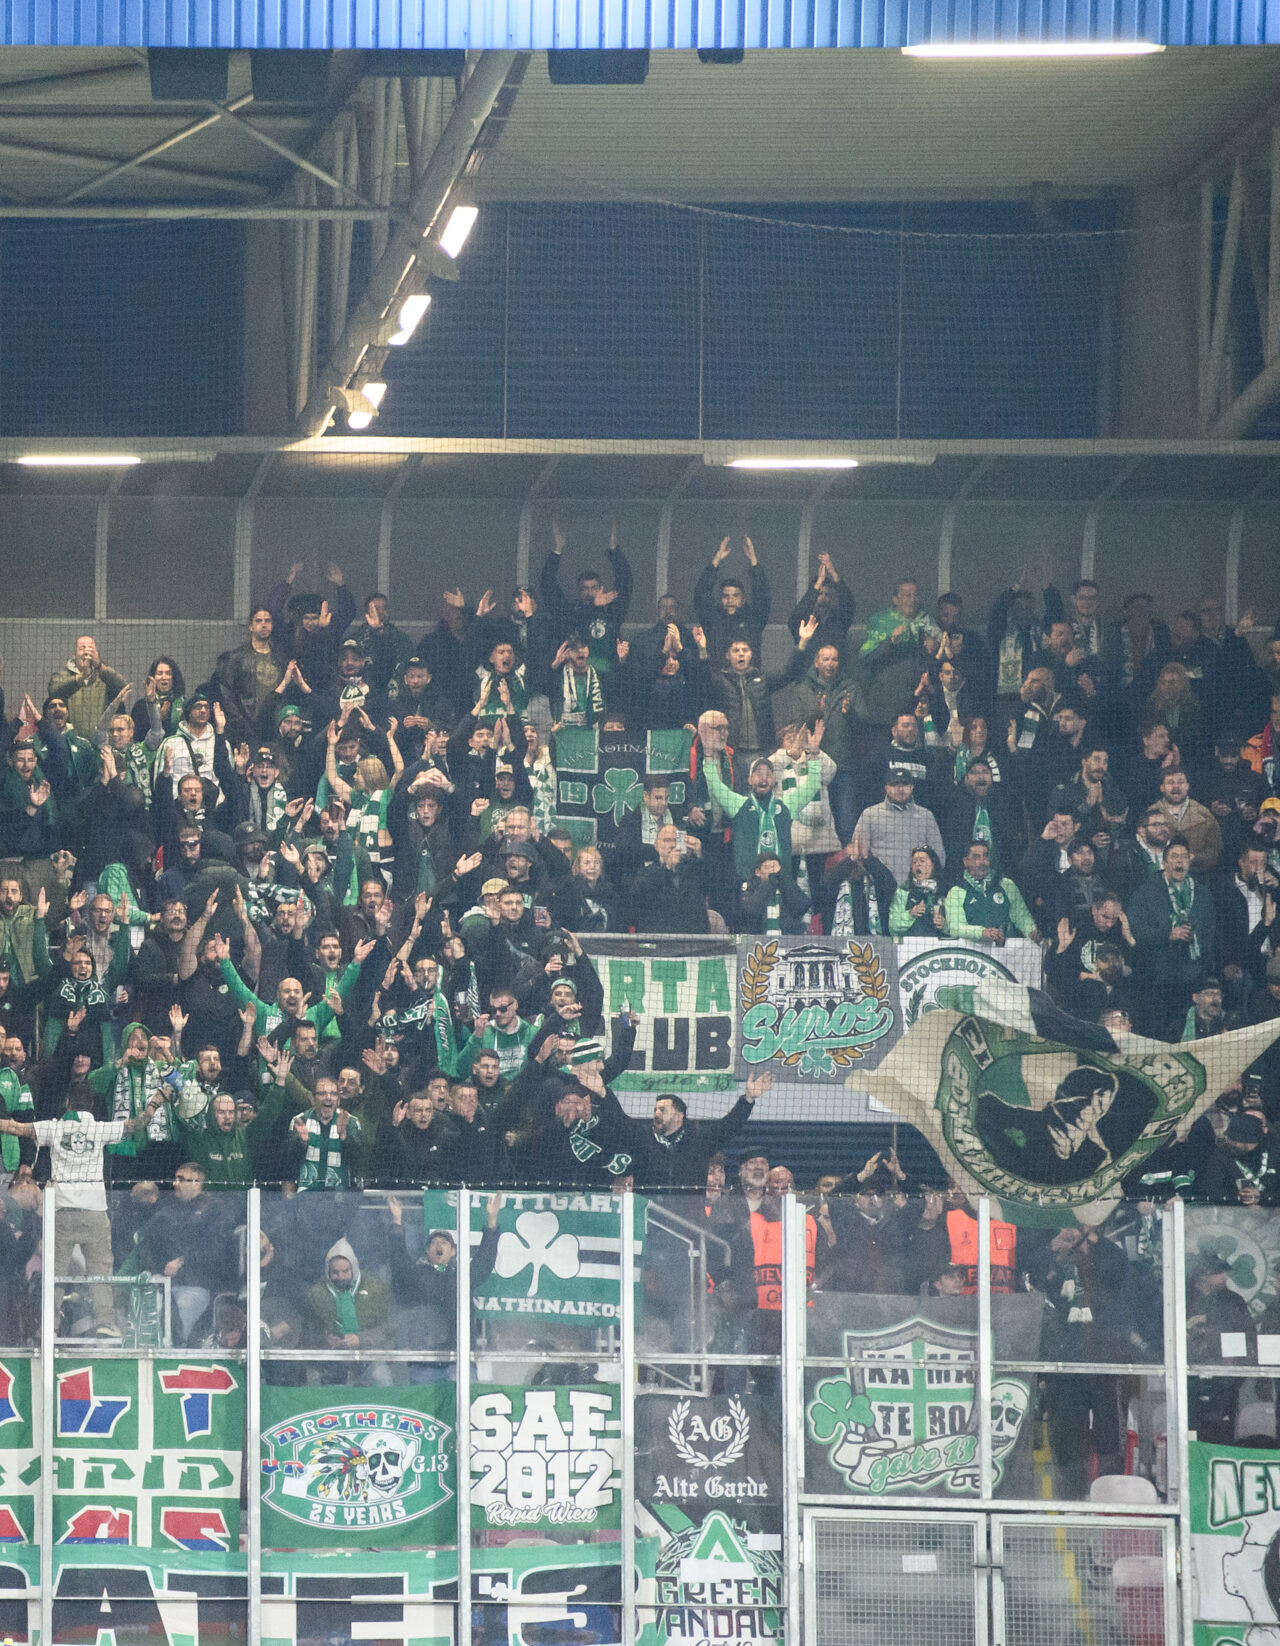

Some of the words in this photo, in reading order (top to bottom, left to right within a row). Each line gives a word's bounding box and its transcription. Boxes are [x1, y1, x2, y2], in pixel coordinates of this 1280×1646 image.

[741, 996, 894, 1065] Syros
[273, 1411, 440, 1446] BROTHERS
[470, 1391, 613, 1451] SAF
[686, 1414, 733, 1442] AG
[877, 1405, 912, 1436] TE
[927, 1404, 968, 1436] RO
[470, 1450, 614, 1508] 2012
[868, 1445, 942, 1492] gate
[653, 1475, 702, 1498] Alte
[705, 1475, 770, 1499] Garde
[343, 1499, 407, 1526] YEARS
[485, 1500, 543, 1526] Rapid
[543, 1501, 598, 1524] Wien
[655, 1575, 783, 1604] GREEN
